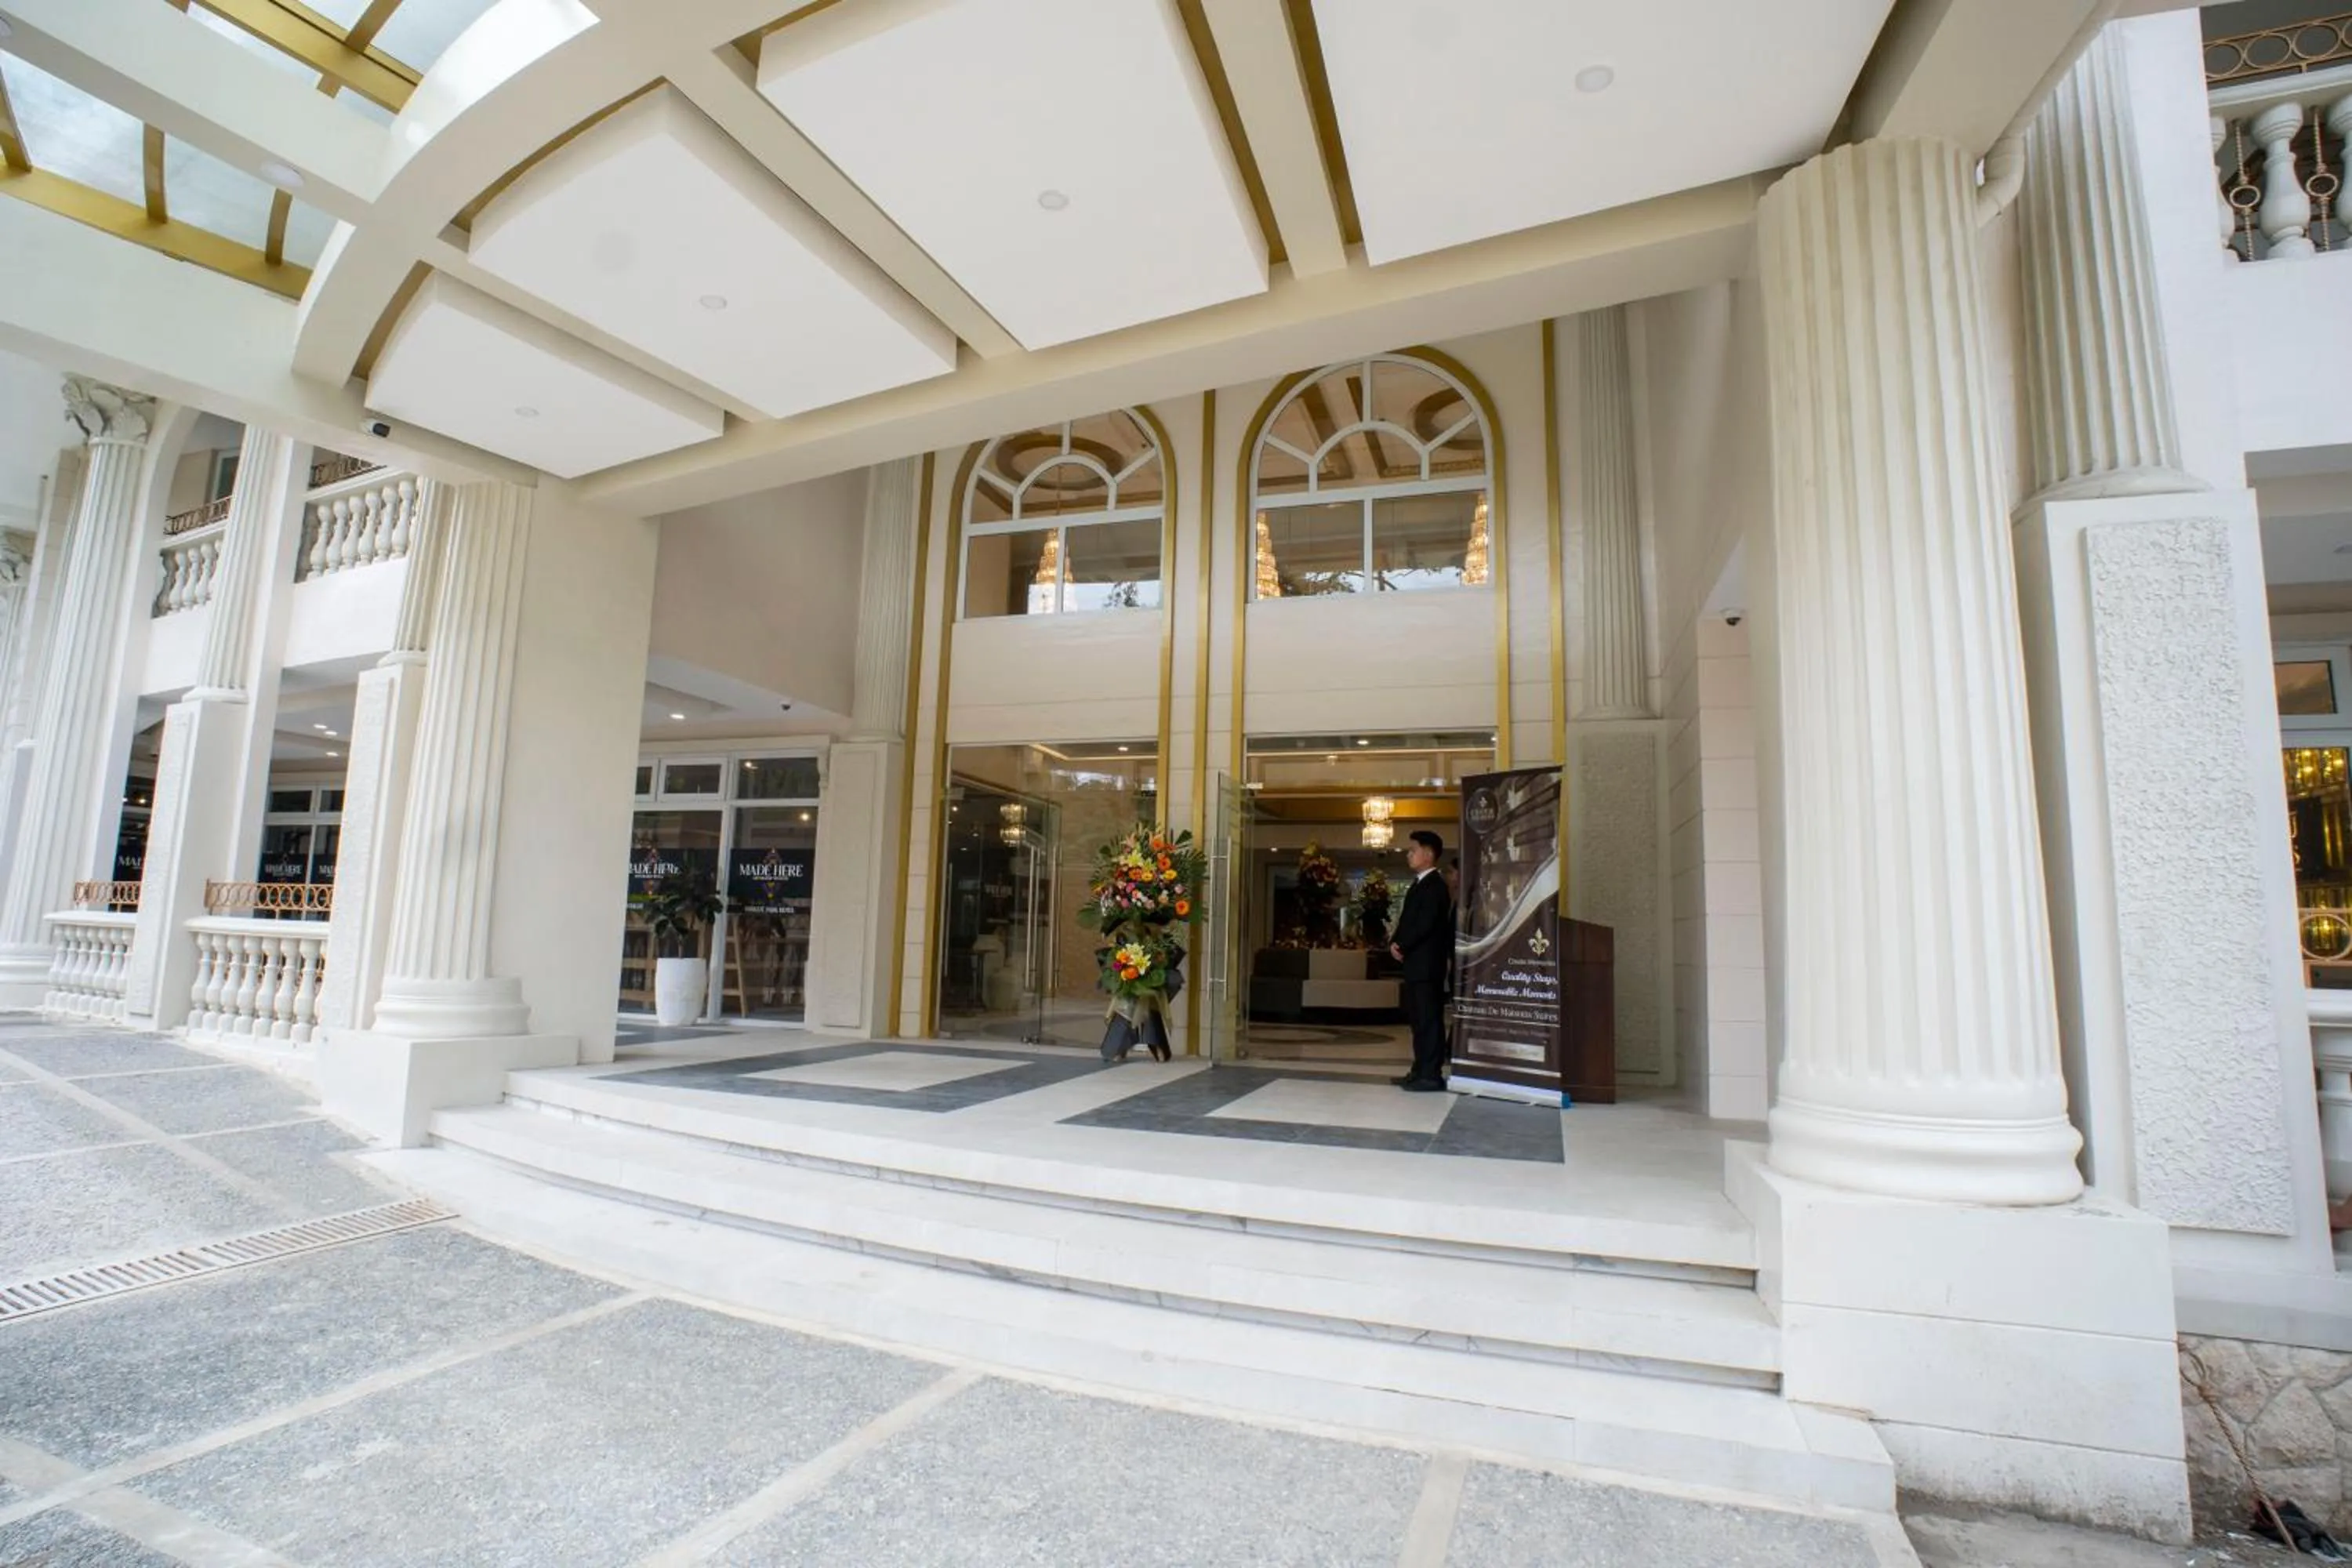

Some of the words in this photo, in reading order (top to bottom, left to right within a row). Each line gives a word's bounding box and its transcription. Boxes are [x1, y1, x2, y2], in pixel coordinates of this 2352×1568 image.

[739, 863, 772, 876] MADE
[773, 864, 804, 877] HERE
[1501, 970, 1531, 985] Quality
[1519, 987, 1556, 1000] Moments
